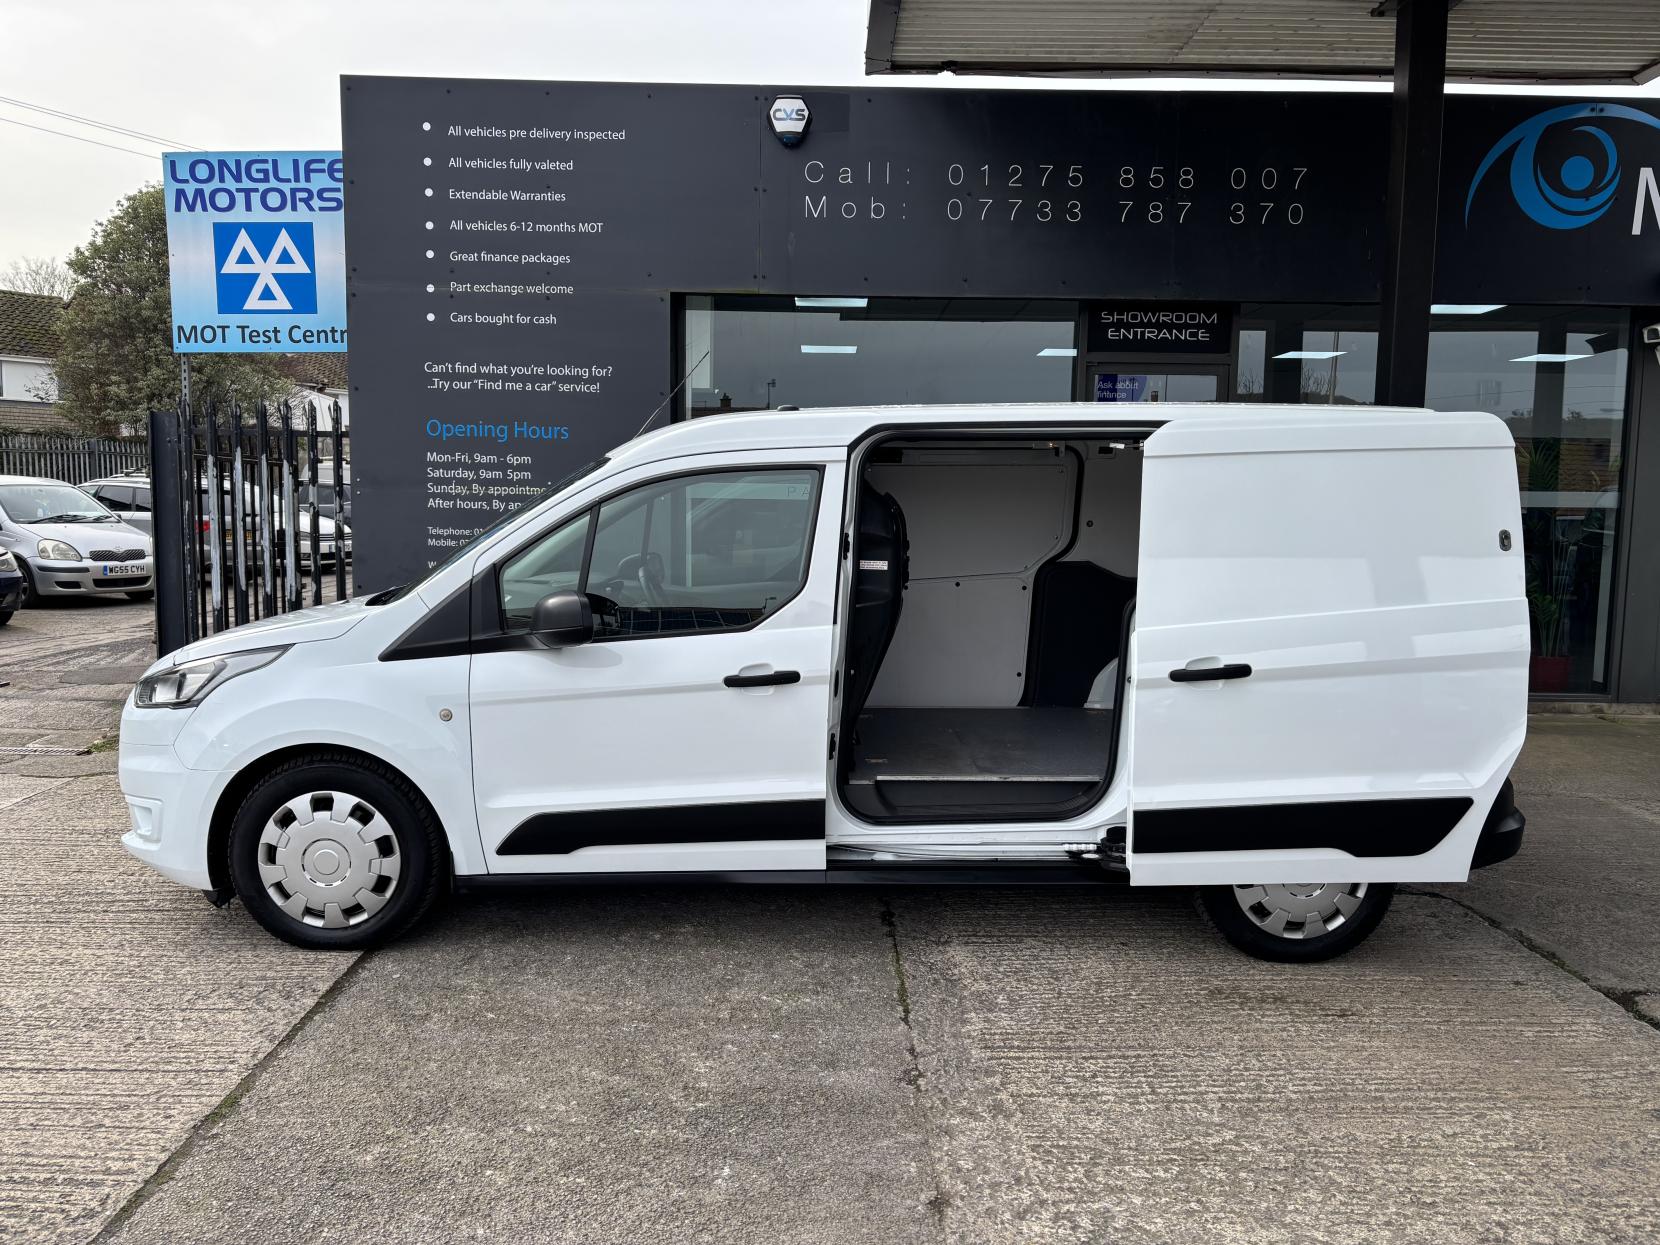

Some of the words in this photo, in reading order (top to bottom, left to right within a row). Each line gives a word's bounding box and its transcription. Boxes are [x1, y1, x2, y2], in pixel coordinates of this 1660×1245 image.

[448, 126, 461, 136] All
[464, 126, 506, 137] vehicles
[510, 130, 526, 140] pre
[530, 128, 571, 141] delivery
[574, 129, 625, 141] inspected
[169, 158, 344, 184] LONGLIFE
[449, 157, 461, 167] All
[465, 158, 506, 168] vehicles
[510, 159, 532, 172] fully
[535, 160, 573, 170] valeted
[804, 160, 910, 185] Call:
[948, 164, 1083, 187] 01275
[1119, 166, 1194, 189] 858
[1231, 167, 1308, 190] 007
[174, 187, 344, 212] MOTORS
[450, 189, 508, 200] Extendable
[510, 191, 565, 201] Warranties
[805, 195, 906, 219] Mob:
[947, 198, 1082, 222] 07733
[1119, 201, 1192, 224] 787
[1229, 202, 1303, 225] 370
[450, 220, 462, 230] All
[466, 221, 507, 231] vehicles
[510, 222, 533, 231] 6-12
[536, 222, 575, 232] months
[579, 223, 603, 232] MOT
[450, 251, 478, 261] Great
[481, 251, 519, 262] finance
[522, 253, 570, 265] packages
[451, 282, 471, 291] Part
[474, 282, 523, 295] exchange
[526, 283, 573, 294] welcome
[450, 313, 472, 322] Cars
[476, 313, 514, 325] bought
[516, 313, 531, 323] for
[534, 314, 556, 324] cash
[1100, 311, 1218, 324] SHOWROOM
[177, 325, 230, 344] MOT
[236, 325, 281, 344] Test
[288, 325, 348, 344] Centr
[1107, 328, 1210, 341] ENTRANCE
[455, 362, 476, 373] find
[480, 363, 508, 374] what
[548, 364, 588, 378] looking
[592, 366, 612, 376] for?
[453, 381, 472, 389] our
[559, 382, 599, 392] service!
[1098, 381, 1113, 389] Ask
[427, 419, 507, 442] Opening
[515, 422, 568, 440] Hours
[427, 452, 471, 464] Mon-Fri,
[474, 453, 497, 463] 9am
[507, 454, 531, 466] 6pm
[427, 467, 476, 481] Saturday,
[479, 470, 502, 478] 9am
[507, 470, 531, 481] 5pm
[427, 482, 470, 496] Sunday,
[473, 484, 485, 496] By
[428, 498, 454, 508] After
[457, 498, 489, 510] hours,
[493, 500, 505, 512] By
[427, 527, 472, 536] Telephone:
[428, 538, 458, 546] Mobile:
[130, 565, 145, 573] CYH
